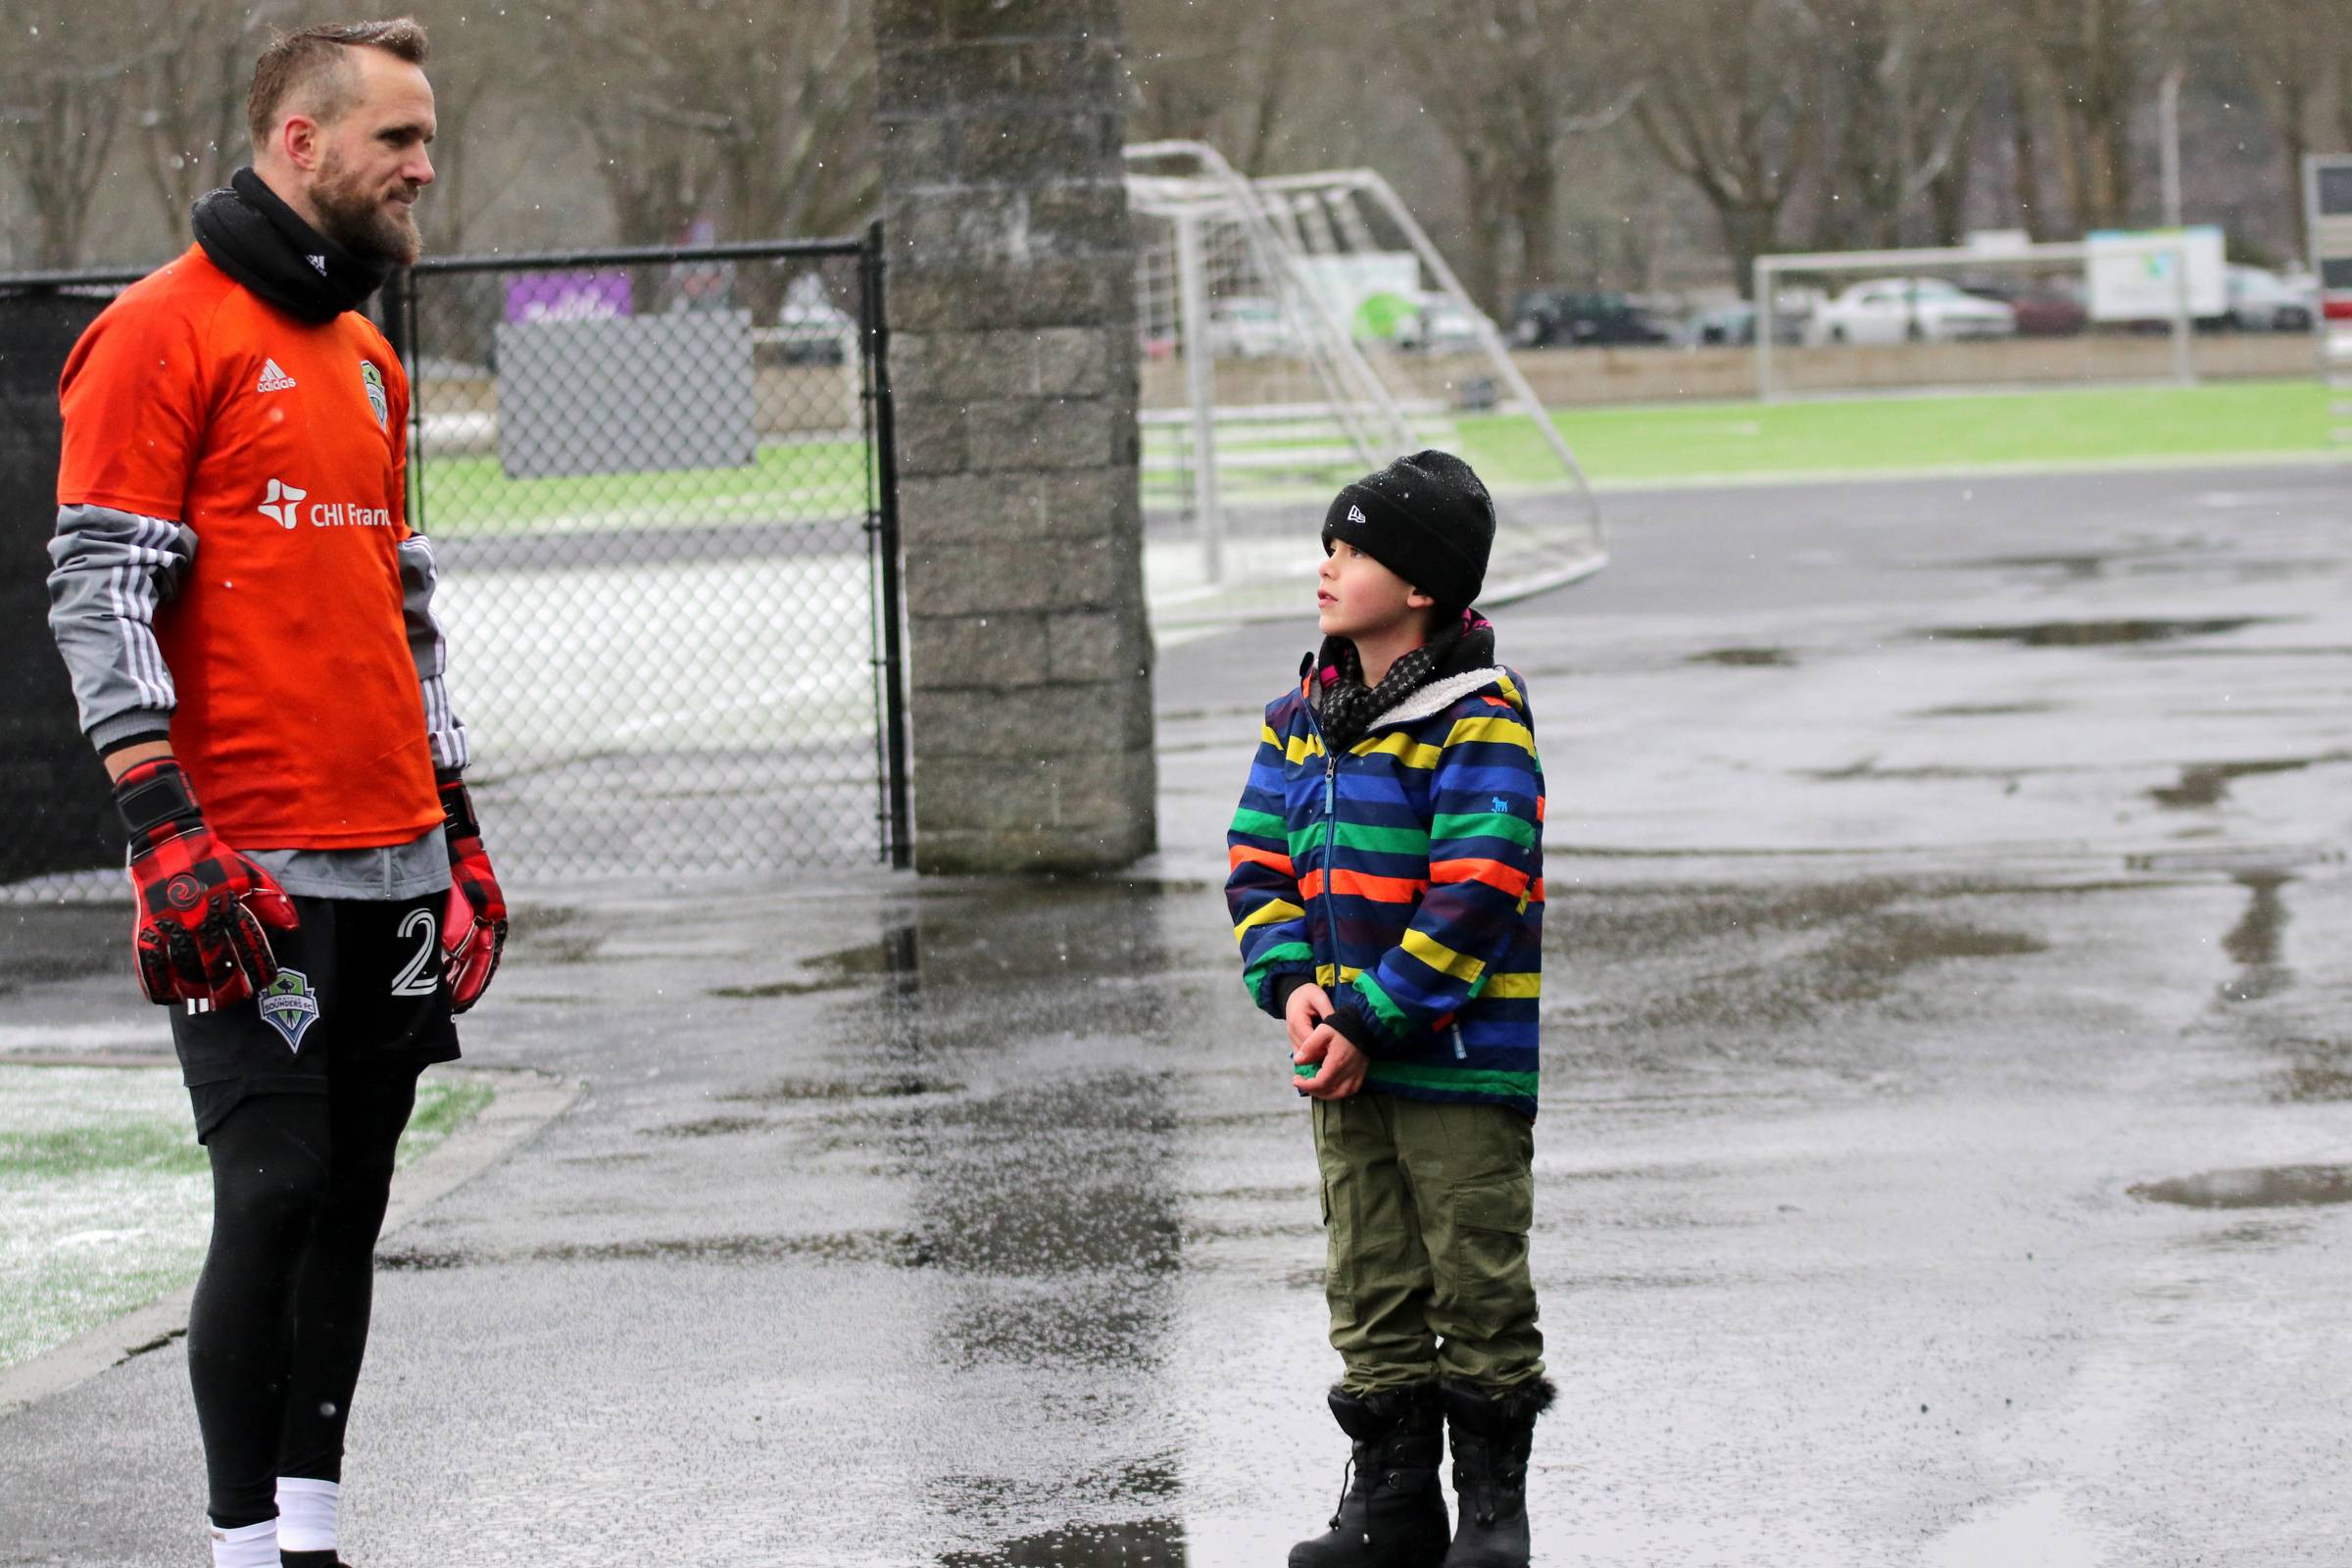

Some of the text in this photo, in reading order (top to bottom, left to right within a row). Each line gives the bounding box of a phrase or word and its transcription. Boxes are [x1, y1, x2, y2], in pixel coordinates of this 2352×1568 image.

[257, 377, 297, 393] adidas
[311, 503, 345, 527] CHI
[265, 1000, 302, 1012] SOUNDERS
